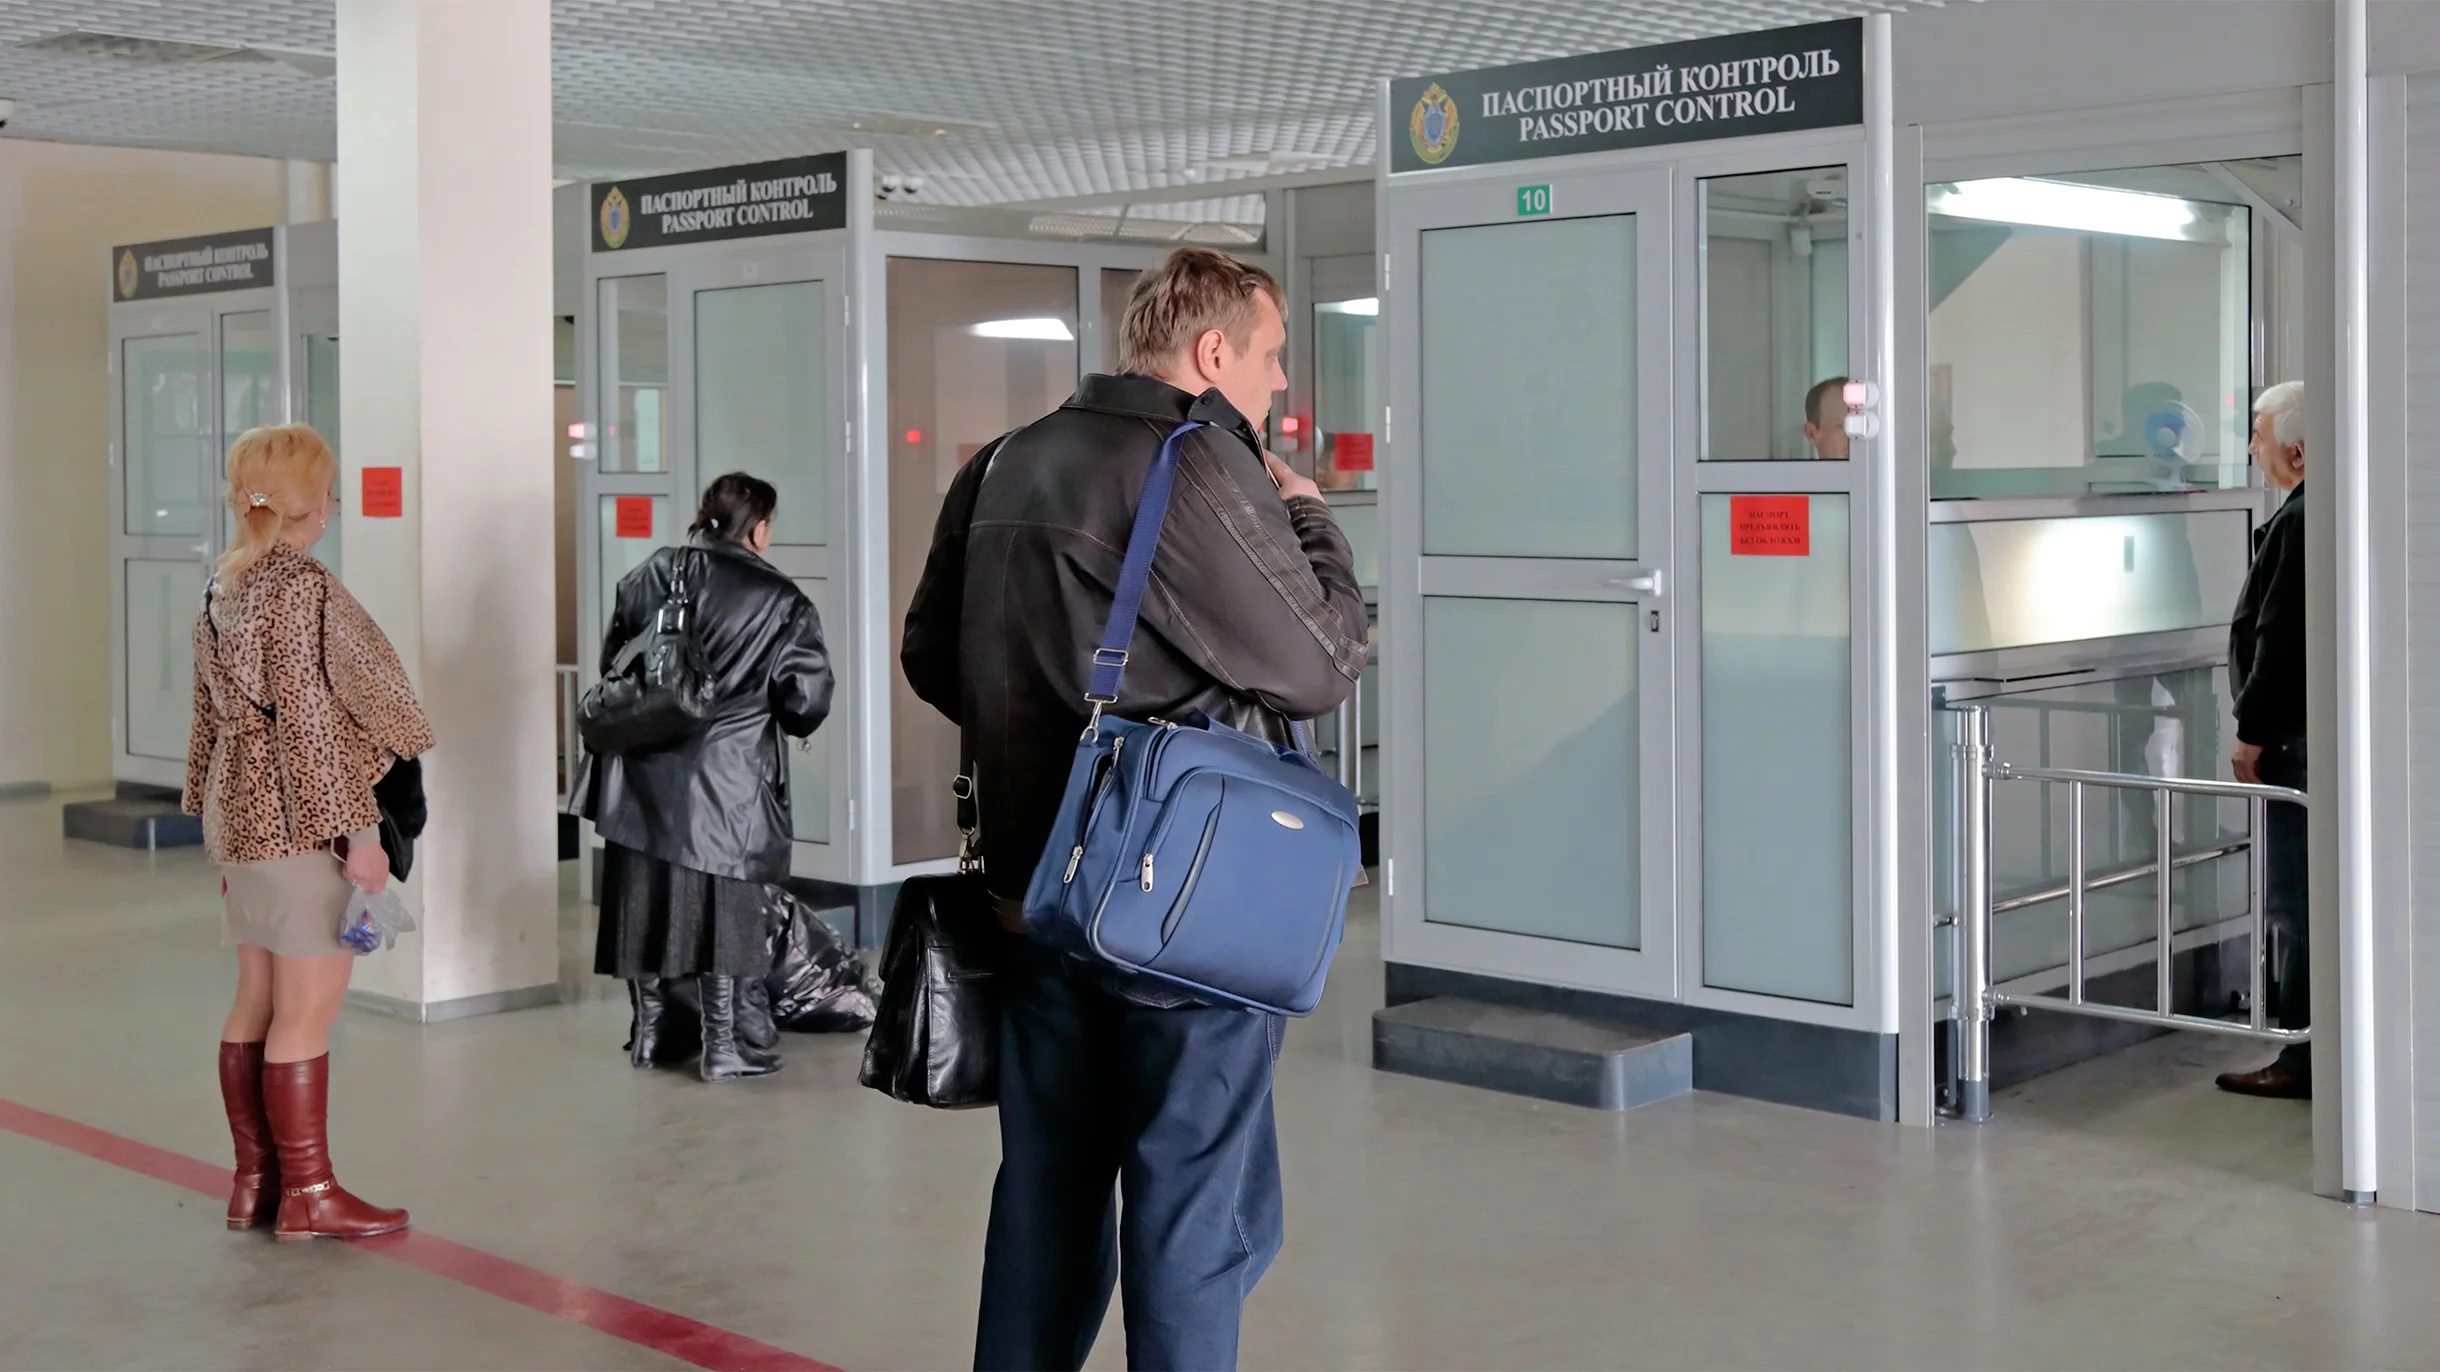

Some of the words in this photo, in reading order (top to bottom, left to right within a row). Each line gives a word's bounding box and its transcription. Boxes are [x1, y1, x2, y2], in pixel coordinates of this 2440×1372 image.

[1482, 63, 1674, 118] ПАСПОРТНЫЙ
[1680, 49, 1840, 93] КОНТРОЛЬ
[1519, 103, 1649, 142] PASSPORT
[1655, 86, 1796, 126] CONTROL
[641, 179, 748, 215] ПАСПОРТНЫЙ
[750, 173, 837, 202] КОНТРОЛЬ
[1522, 189, 1546, 211] 10
[662, 207, 735, 234] PASSPORT
[736, 198, 814, 226] CONTROL
